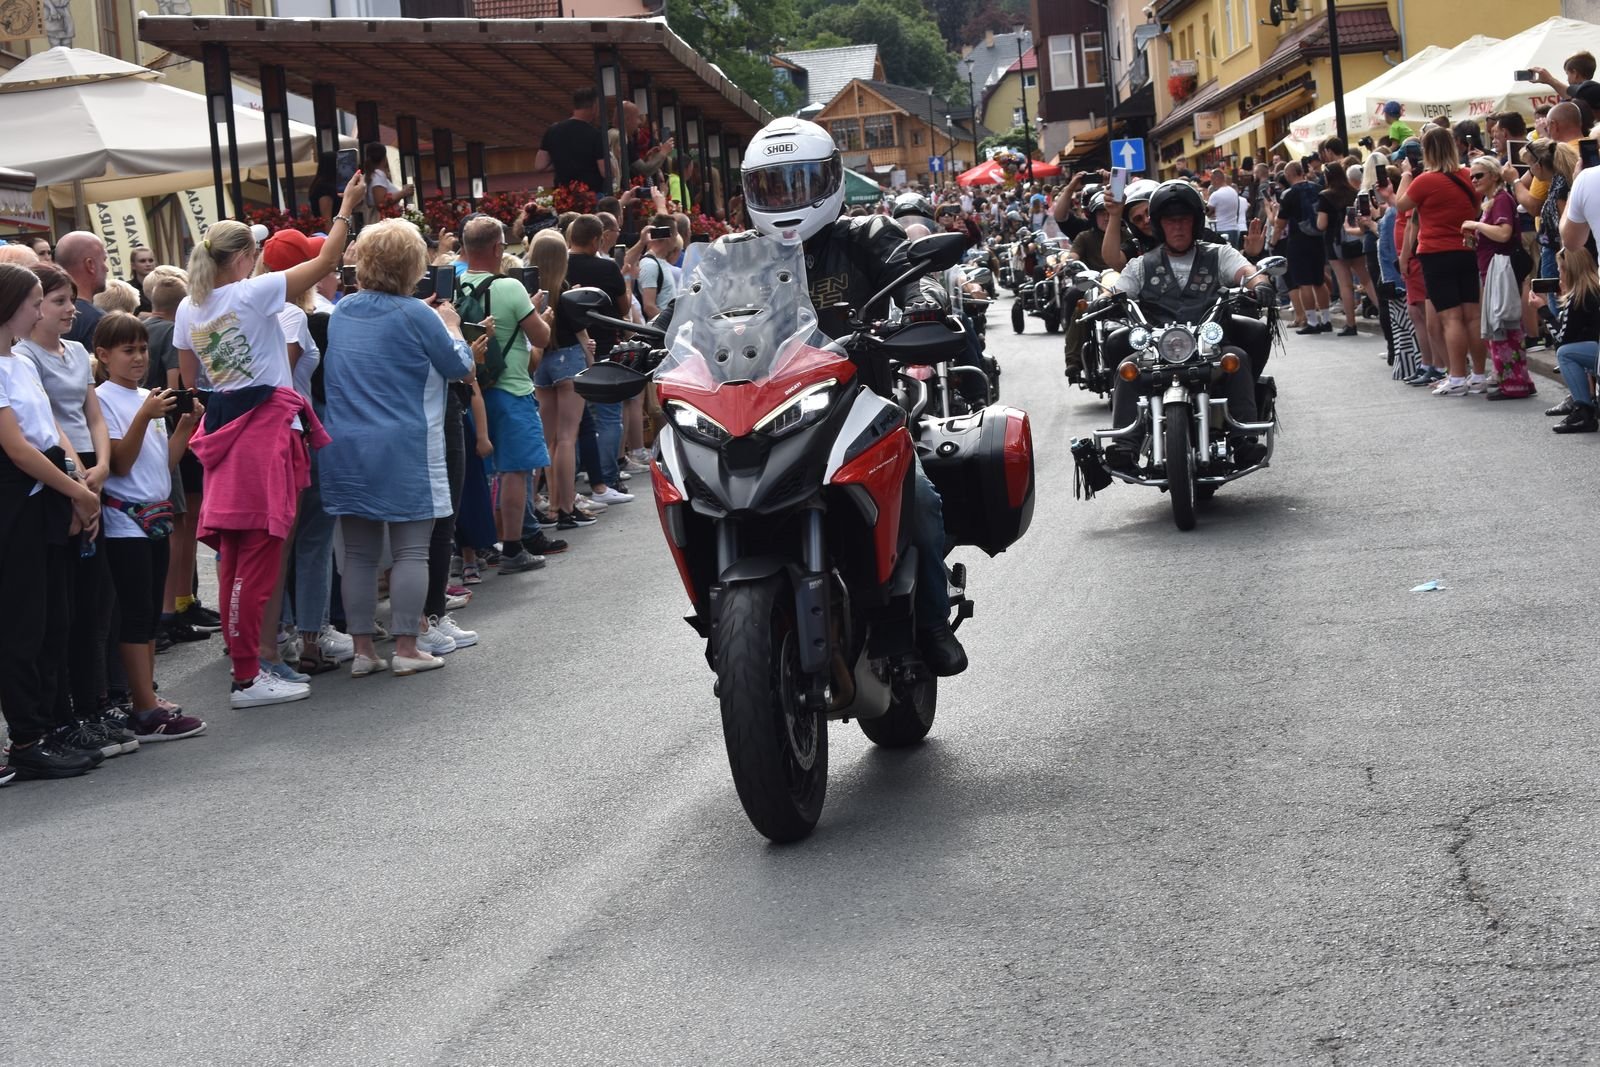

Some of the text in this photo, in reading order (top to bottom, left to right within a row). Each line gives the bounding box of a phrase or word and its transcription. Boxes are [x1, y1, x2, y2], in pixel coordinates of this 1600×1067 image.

[1420, 104, 1453, 118] VERDE
[767, 144, 793, 154] SHOEI
[234, 335, 251, 355] 3
[784, 382, 802, 395] DUCATI
